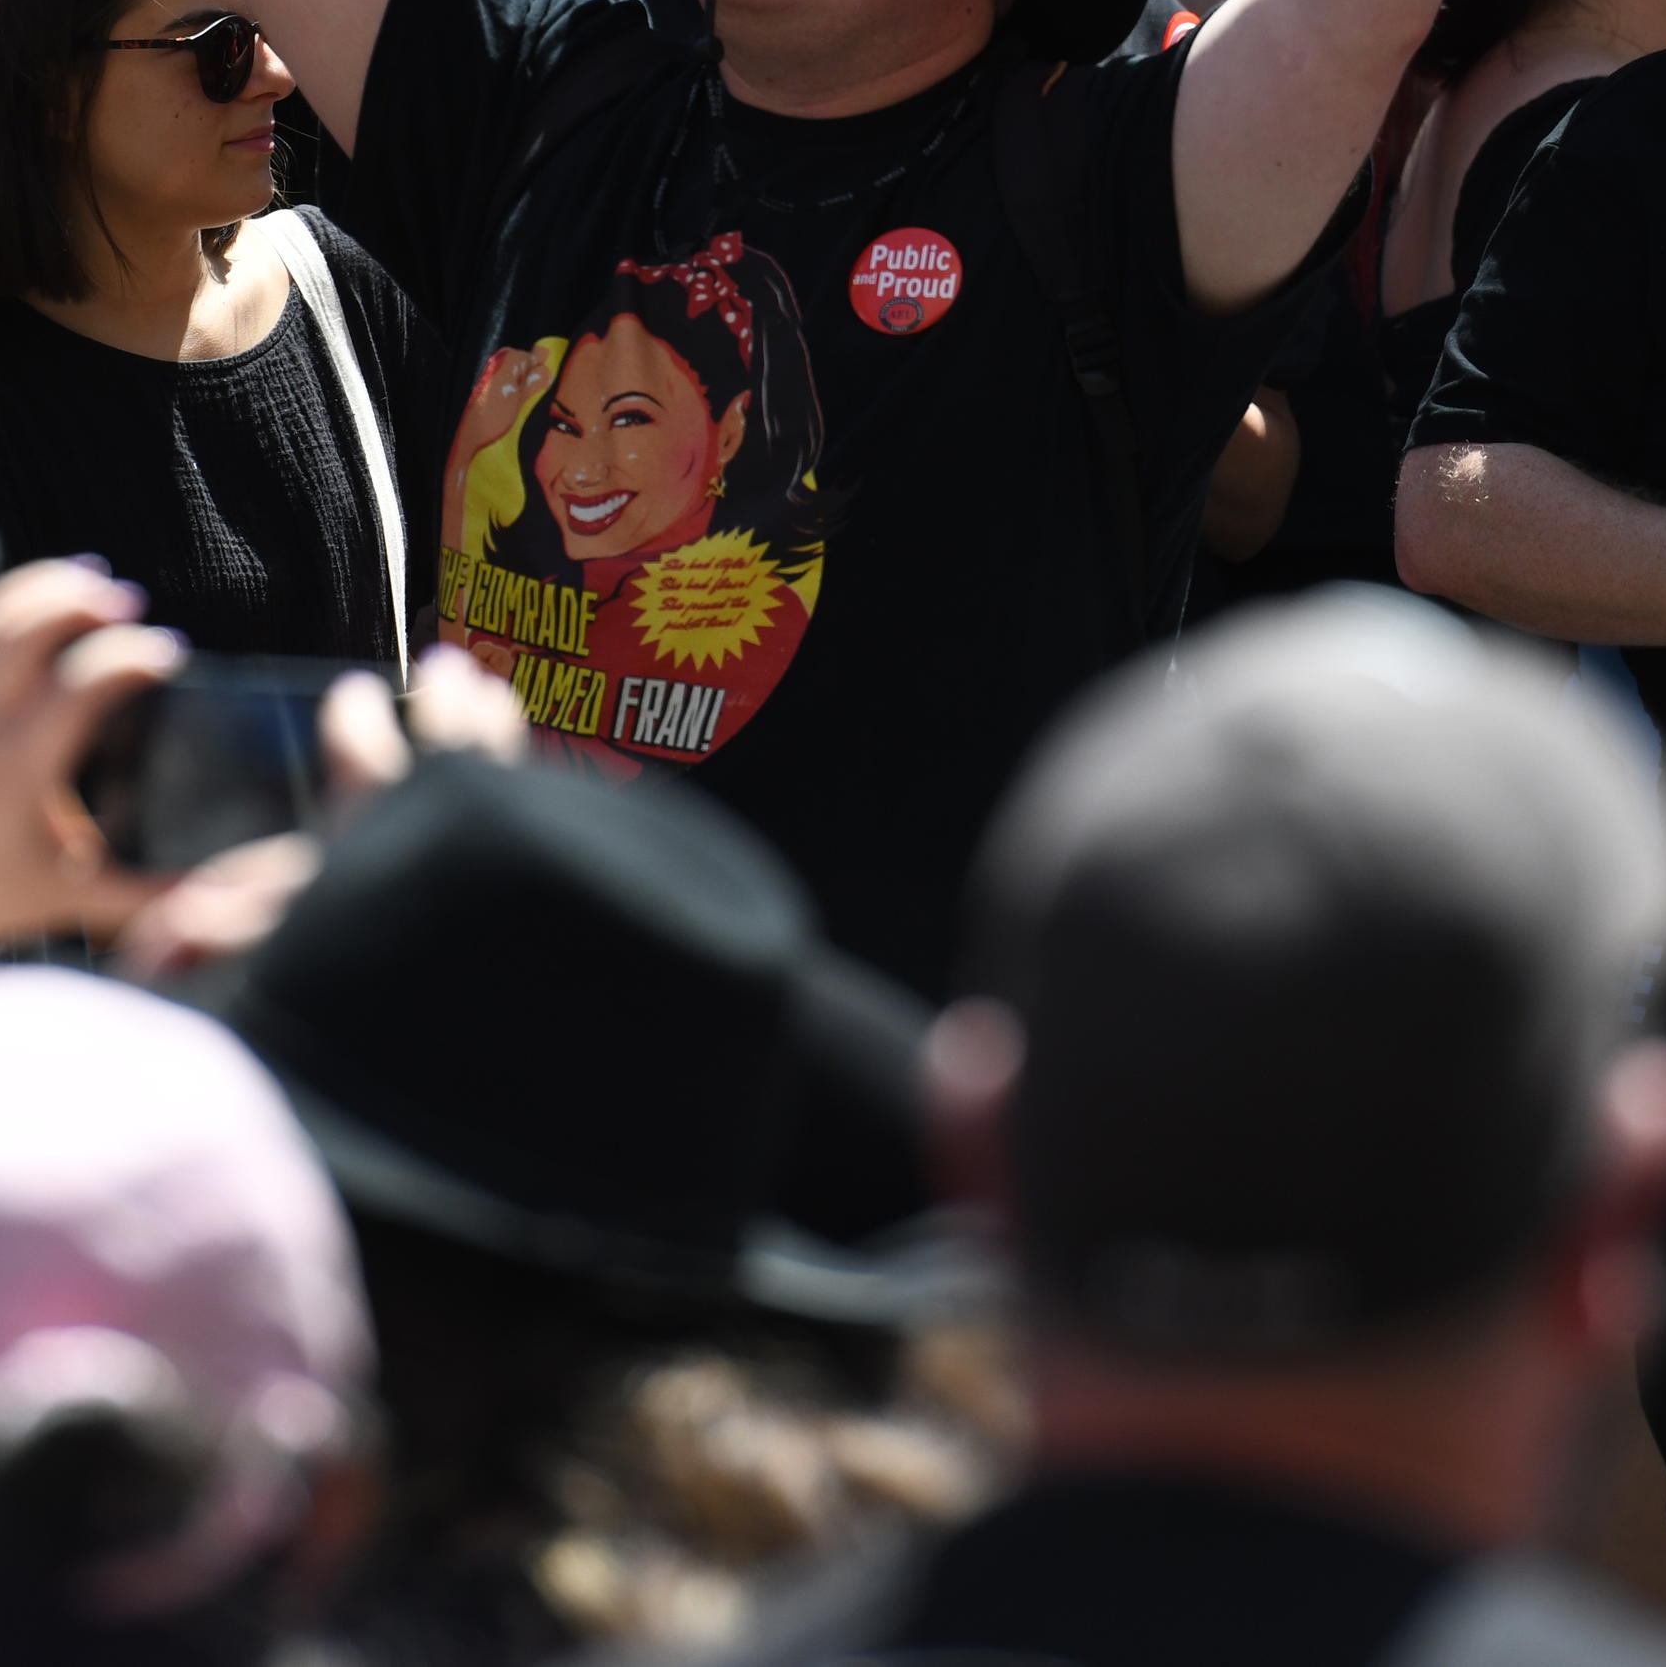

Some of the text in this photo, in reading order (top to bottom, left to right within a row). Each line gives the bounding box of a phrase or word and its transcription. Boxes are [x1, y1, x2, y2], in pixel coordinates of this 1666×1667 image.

[852, 270, 958, 299] and Proud
[870, 243, 952, 271] Public
[436, 546, 599, 656] THE COMRADE
[509, 652, 727, 753] NAMED FRAN!
